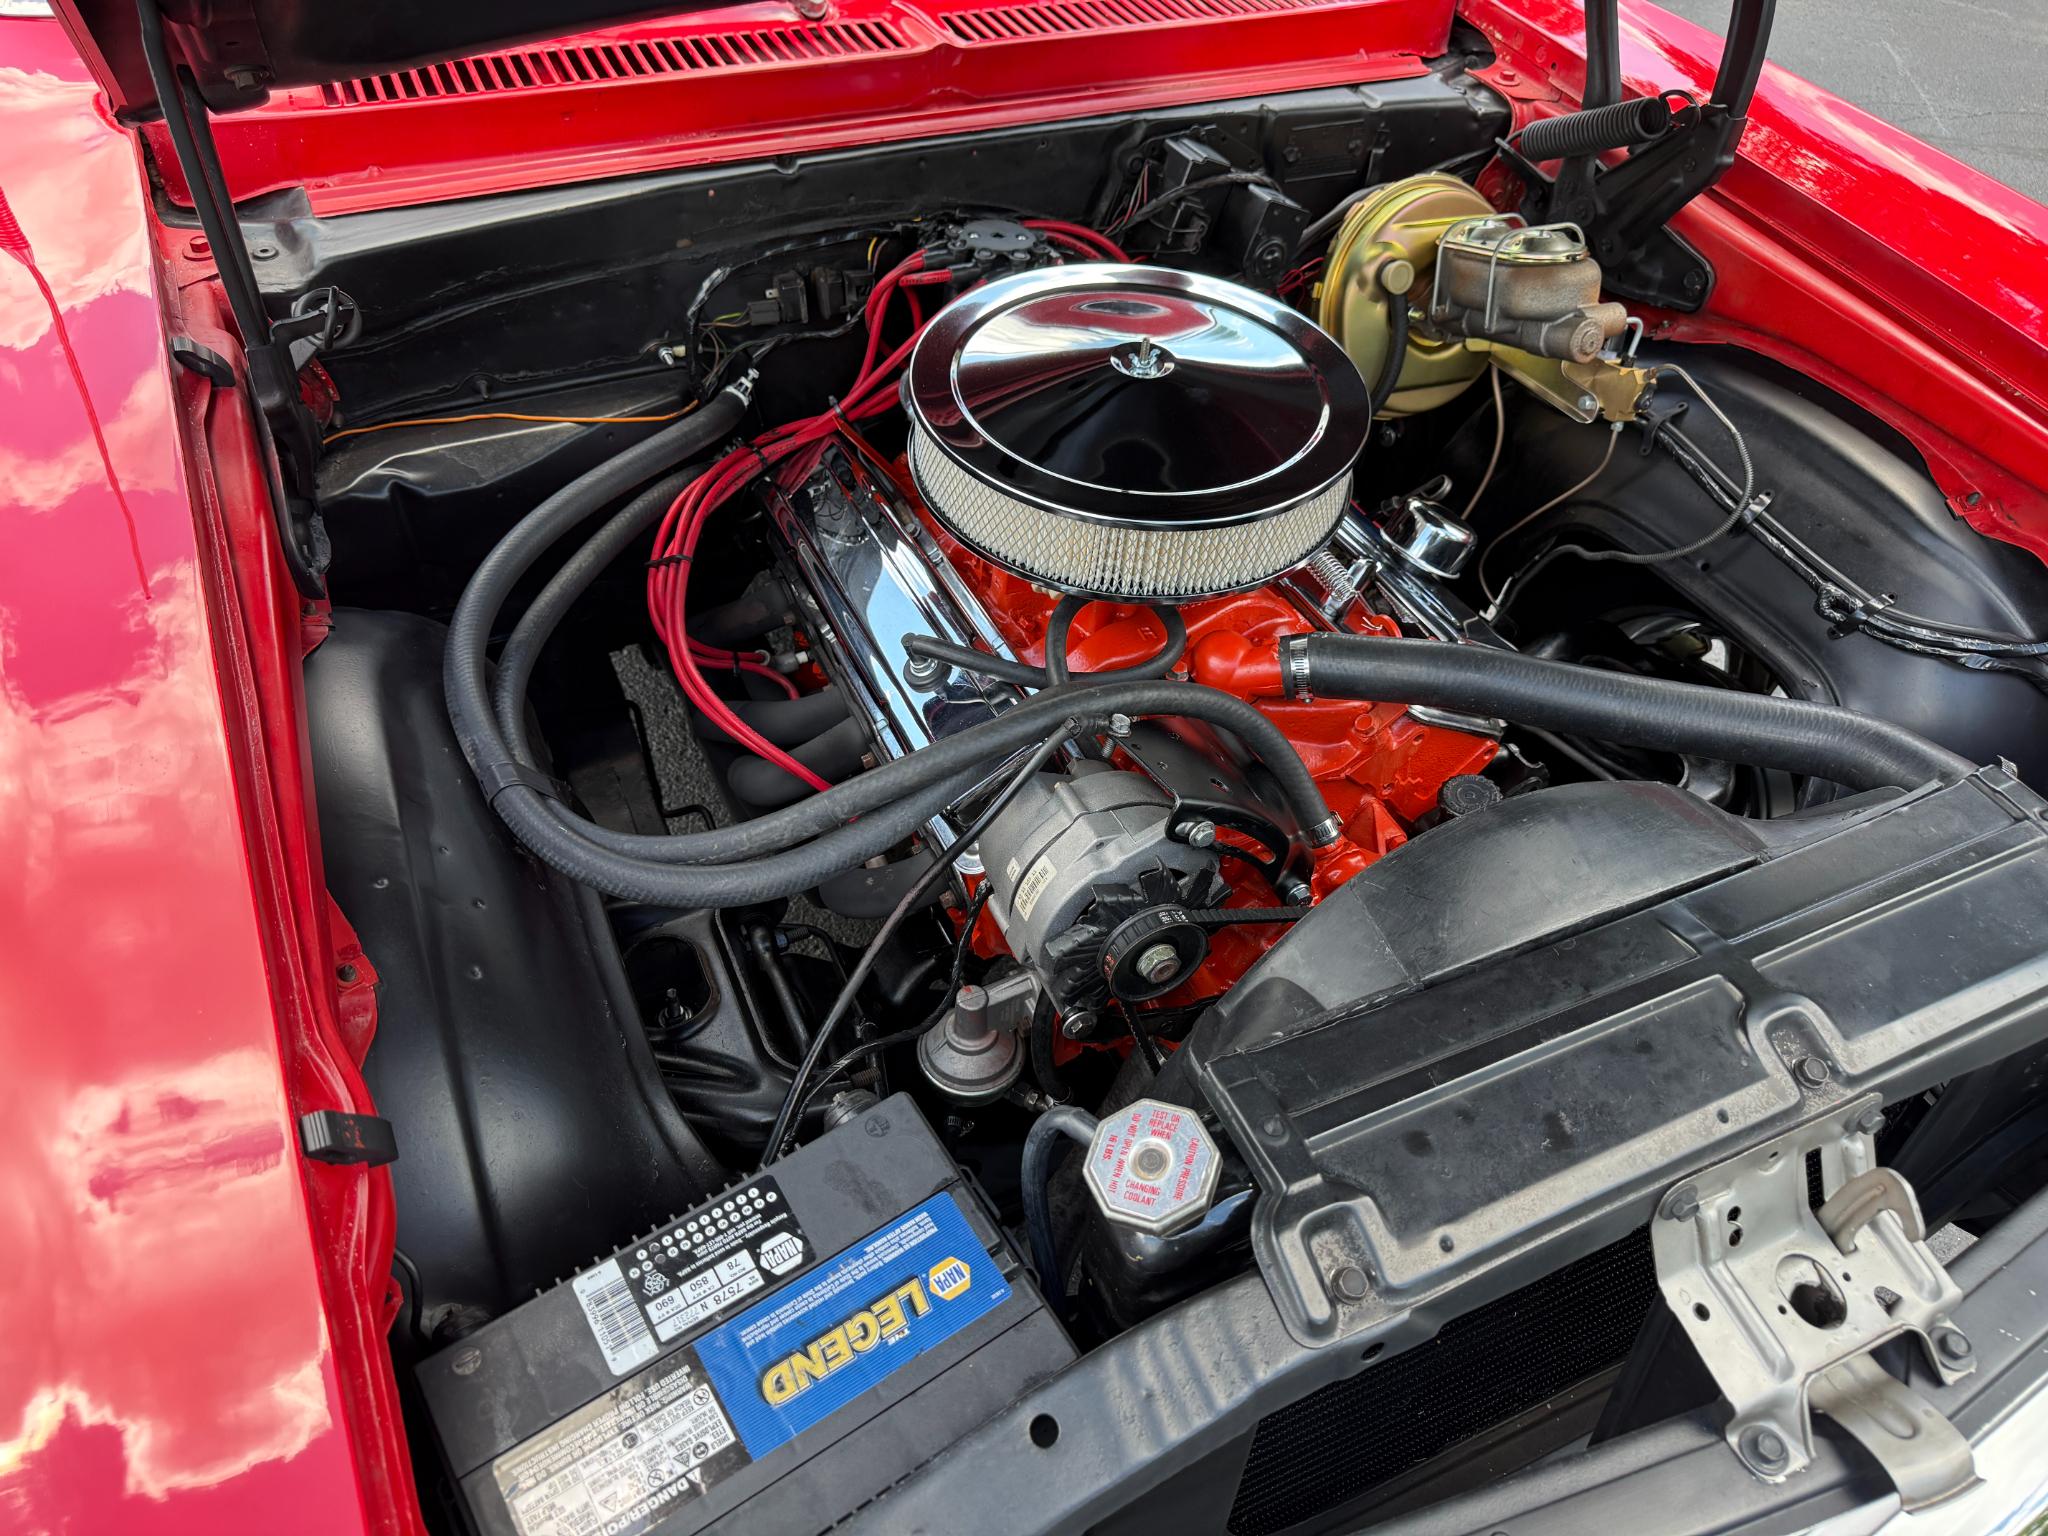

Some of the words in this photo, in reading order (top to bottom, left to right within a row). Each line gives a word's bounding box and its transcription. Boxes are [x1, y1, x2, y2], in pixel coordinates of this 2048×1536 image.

[1131, 1113, 1142, 1122] DO
[1152, 1110, 1168, 1119] TEST
[1171, 1114, 1181, 1123] OR
[1126, 1123, 1138, 1137] NOT
[1149, 1119, 1178, 1132] REPLACE
[1151, 1131, 1172, 1140] WHEN
[1120, 1138, 1132, 1156] OPEN
[1184, 1137, 1200, 1167] CAUTION
[1113, 1158, 1126, 1179] WHEN
[1108, 1179, 1118, 1193] HOT
[1125, 1179, 1161, 1195] CHANGING
[1174, 1167, 1192, 1201] PRESSURE
[1124, 1191, 1156, 1206] COOLANT
[763, 1238, 799, 1268] NAPA
[725, 1257, 740, 1271] 78
[687, 1275, 709, 1292] 850
[932, 1263, 966, 1294] NAPA
[711, 1281, 744, 1306] 7578
[653, 1294, 675, 1311] 690
[698, 1300, 708, 1311] N
[584, 1301, 601, 1326] 83996
[596, 1325, 612, 1350] 11051
[758, 1275, 932, 1406] LEGEND
